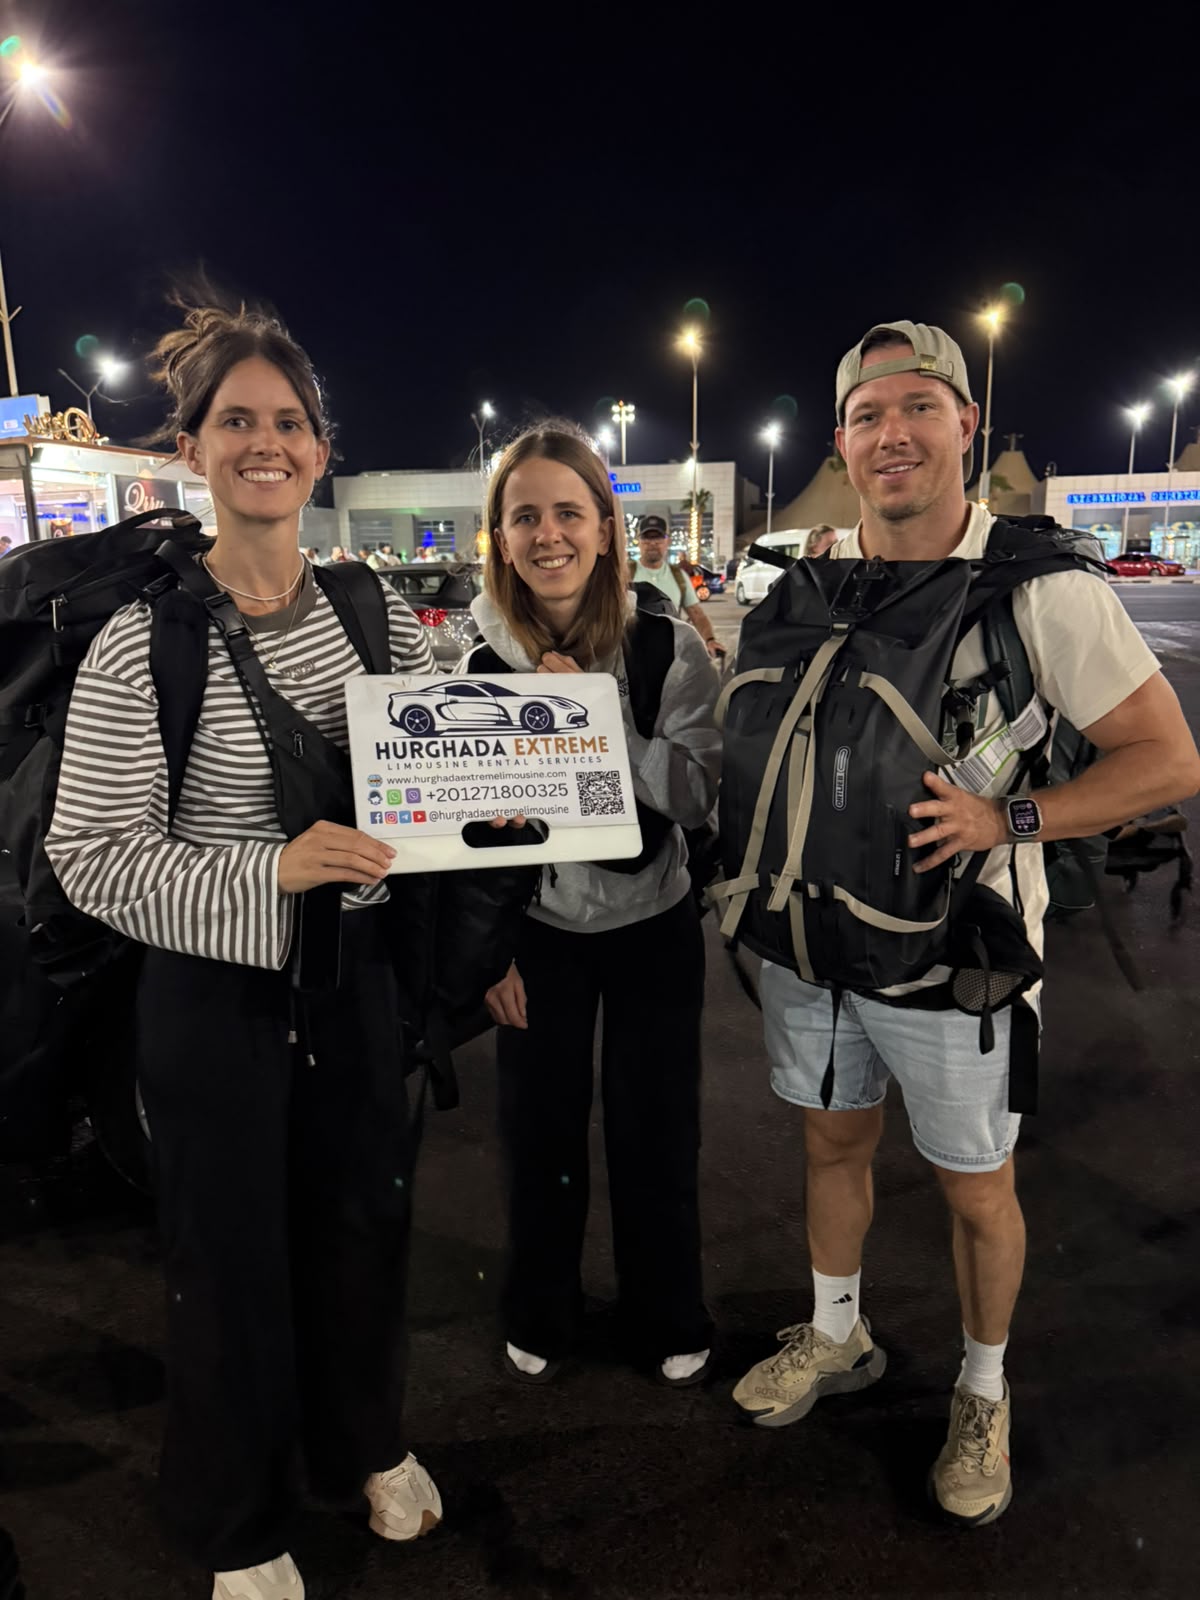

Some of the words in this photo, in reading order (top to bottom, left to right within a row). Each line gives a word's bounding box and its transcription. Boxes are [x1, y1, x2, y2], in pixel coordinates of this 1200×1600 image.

[1067, 493, 1145, 504] INTERNATIONAL
[375, 738, 507, 760] HURGHADA
[514, 735, 609, 756] EXTREME
[387, 760, 468, 770] LIMOUSINE
[478, 758, 529, 767] RENTAL
[538, 755, 602, 765] SERVICES
[386, 769, 567, 785] www.hurghadaextremelimousine.com
[426, 782, 569, 802] +201271800325
[429, 804, 569, 822] @hurghadaextremelimousine
